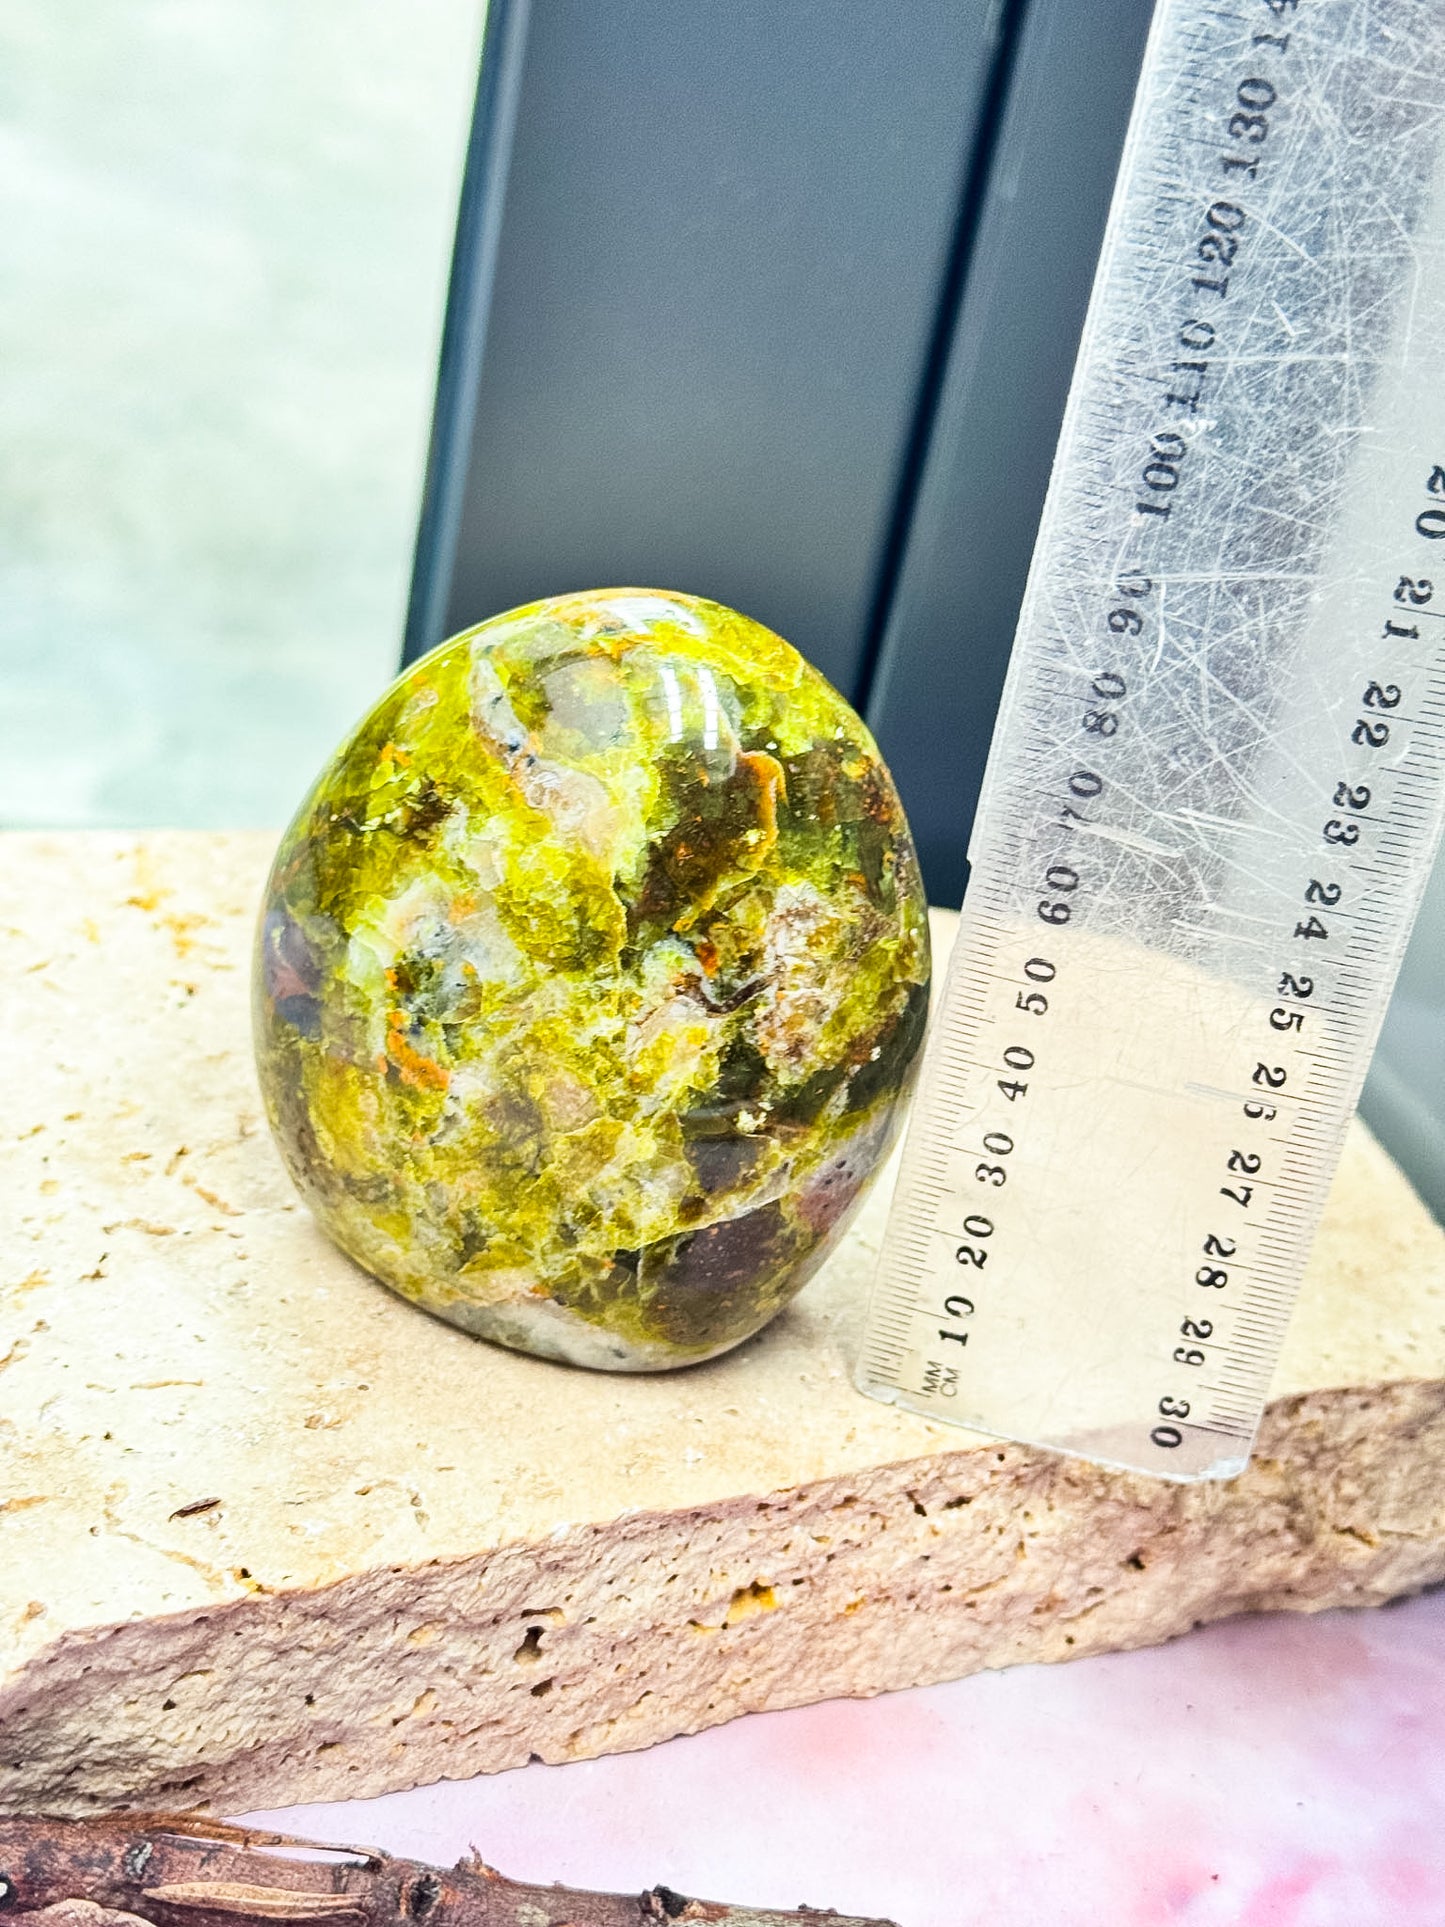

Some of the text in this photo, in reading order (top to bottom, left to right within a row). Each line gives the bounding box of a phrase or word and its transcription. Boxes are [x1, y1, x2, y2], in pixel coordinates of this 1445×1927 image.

[1222, 77, 1278, 180] 130
[1191, 201, 1247, 300] 120
[1165, 319, 1217, 414] 110
[1136, 432, 1188, 523] 100
[1108, 568, 1153, 638] 90
[1381, 575, 1435, 641] 21
[1081, 671, 1127, 739] 80
[1351, 680, 1402, 749] 22
[1322, 780, 1372, 847] 23
[1036, 865, 1081, 926] 60
[1293, 878, 1342, 941] 24
[1015, 957, 1057, 1017] 50
[1268, 971, 1315, 1034] 25
[996, 1045, 1036, 1103] 40
[1242, 1062, 1288, 1122] 26
[974, 1131, 1015, 1188] 30
[1219, 1149, 1263, 1209] 27
[955, 1214, 995, 1271] 20
[1195, 1233, 1237, 1291] 28
[938, 1294, 976, 1348] 10
[1172, 1315, 1214, 1368] 29
[921, 1360, 943, 1393] MM
[939, 1367, 962, 1397] CM
[1149, 1396, 1191, 1449] 30
